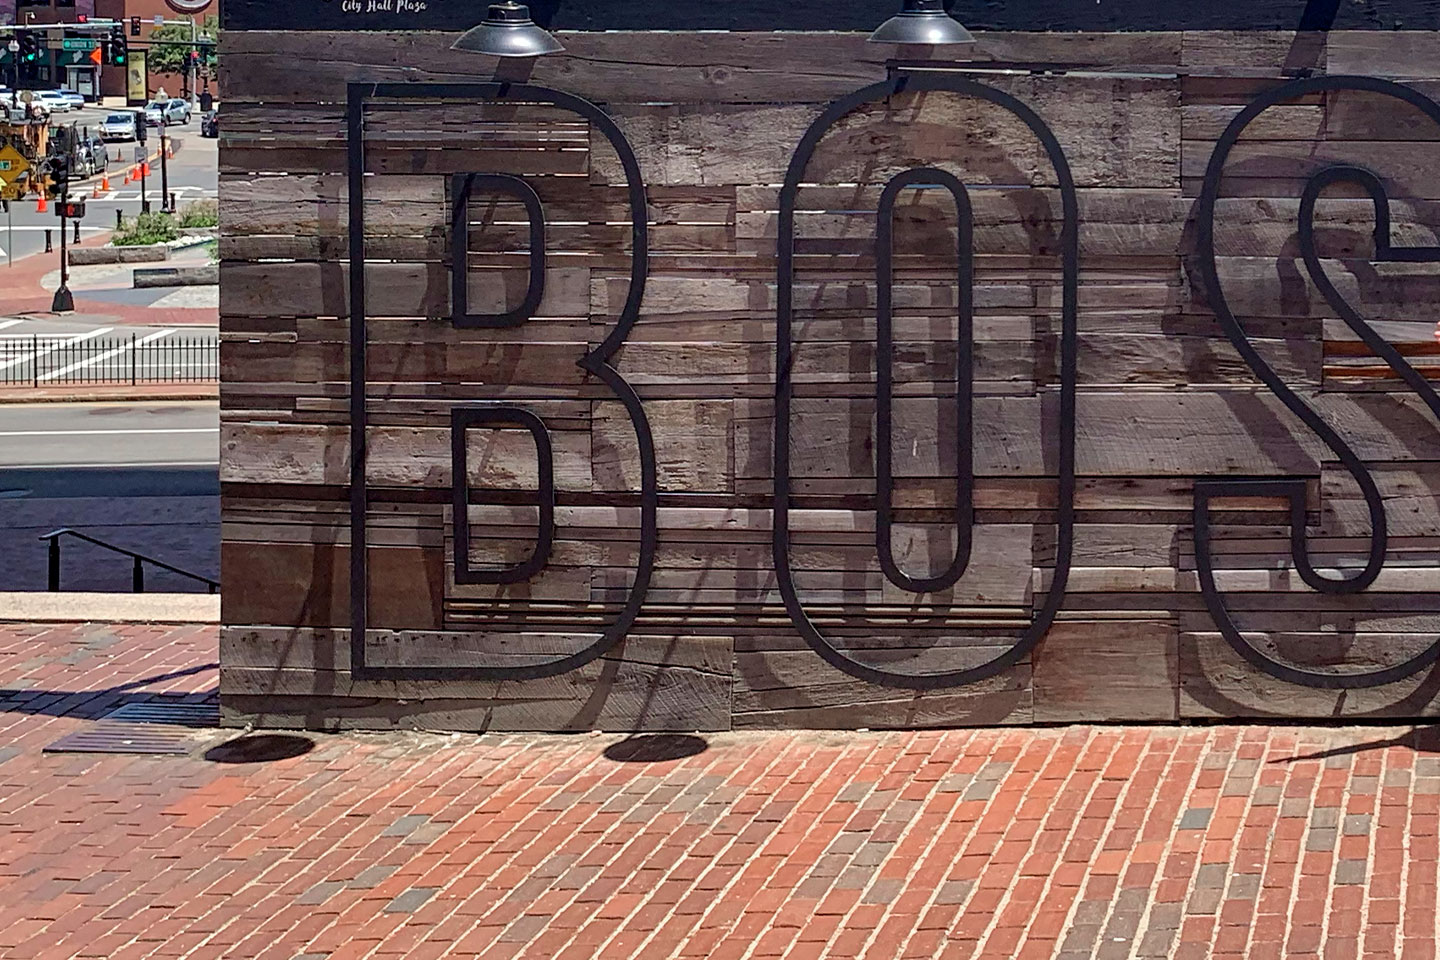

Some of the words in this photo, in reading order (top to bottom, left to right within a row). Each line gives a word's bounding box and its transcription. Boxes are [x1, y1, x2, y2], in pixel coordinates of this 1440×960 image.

[342, 0, 361, 12] City
[366, 0, 391, 12] Hall
[396, 0, 427, 14] Plaza
